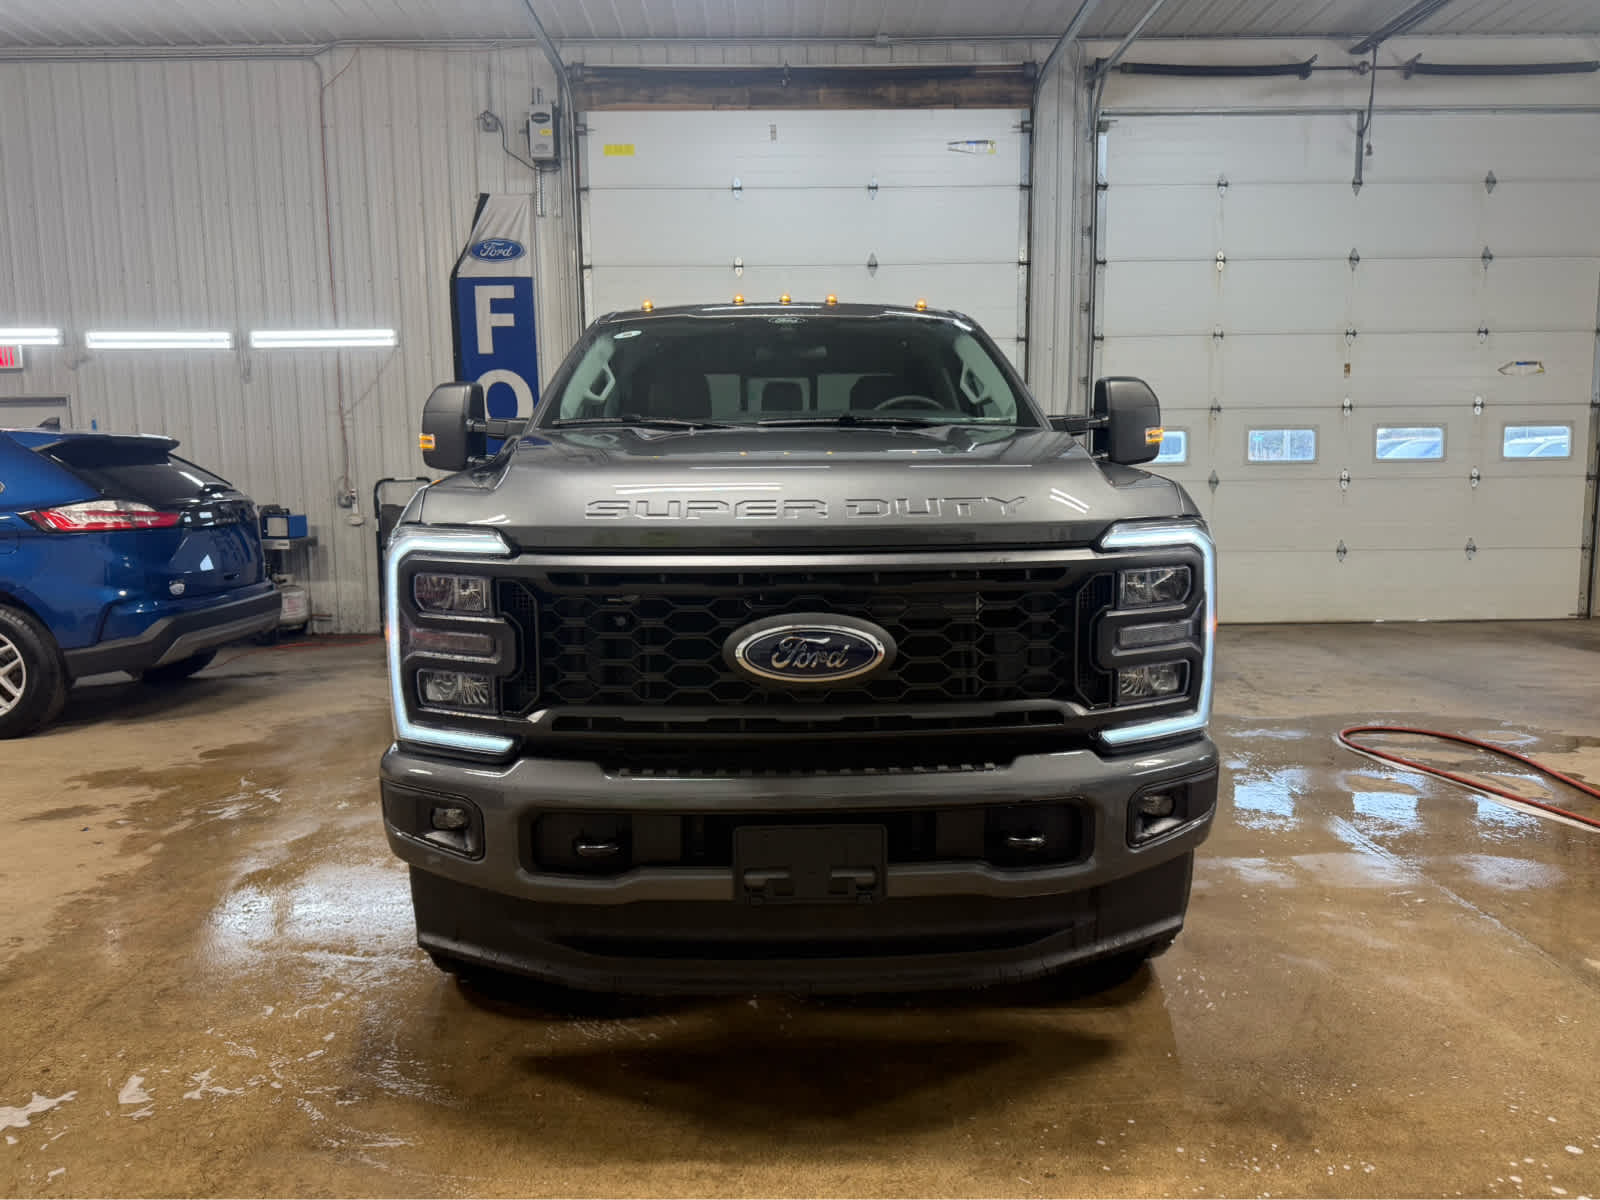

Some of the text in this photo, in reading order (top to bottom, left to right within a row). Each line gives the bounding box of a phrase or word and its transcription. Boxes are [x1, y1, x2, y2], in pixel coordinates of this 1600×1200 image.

[479, 242, 514, 257] Ford
[585, 496, 1027, 520] SUPER DUTY
[771, 636, 851, 669] Ford
